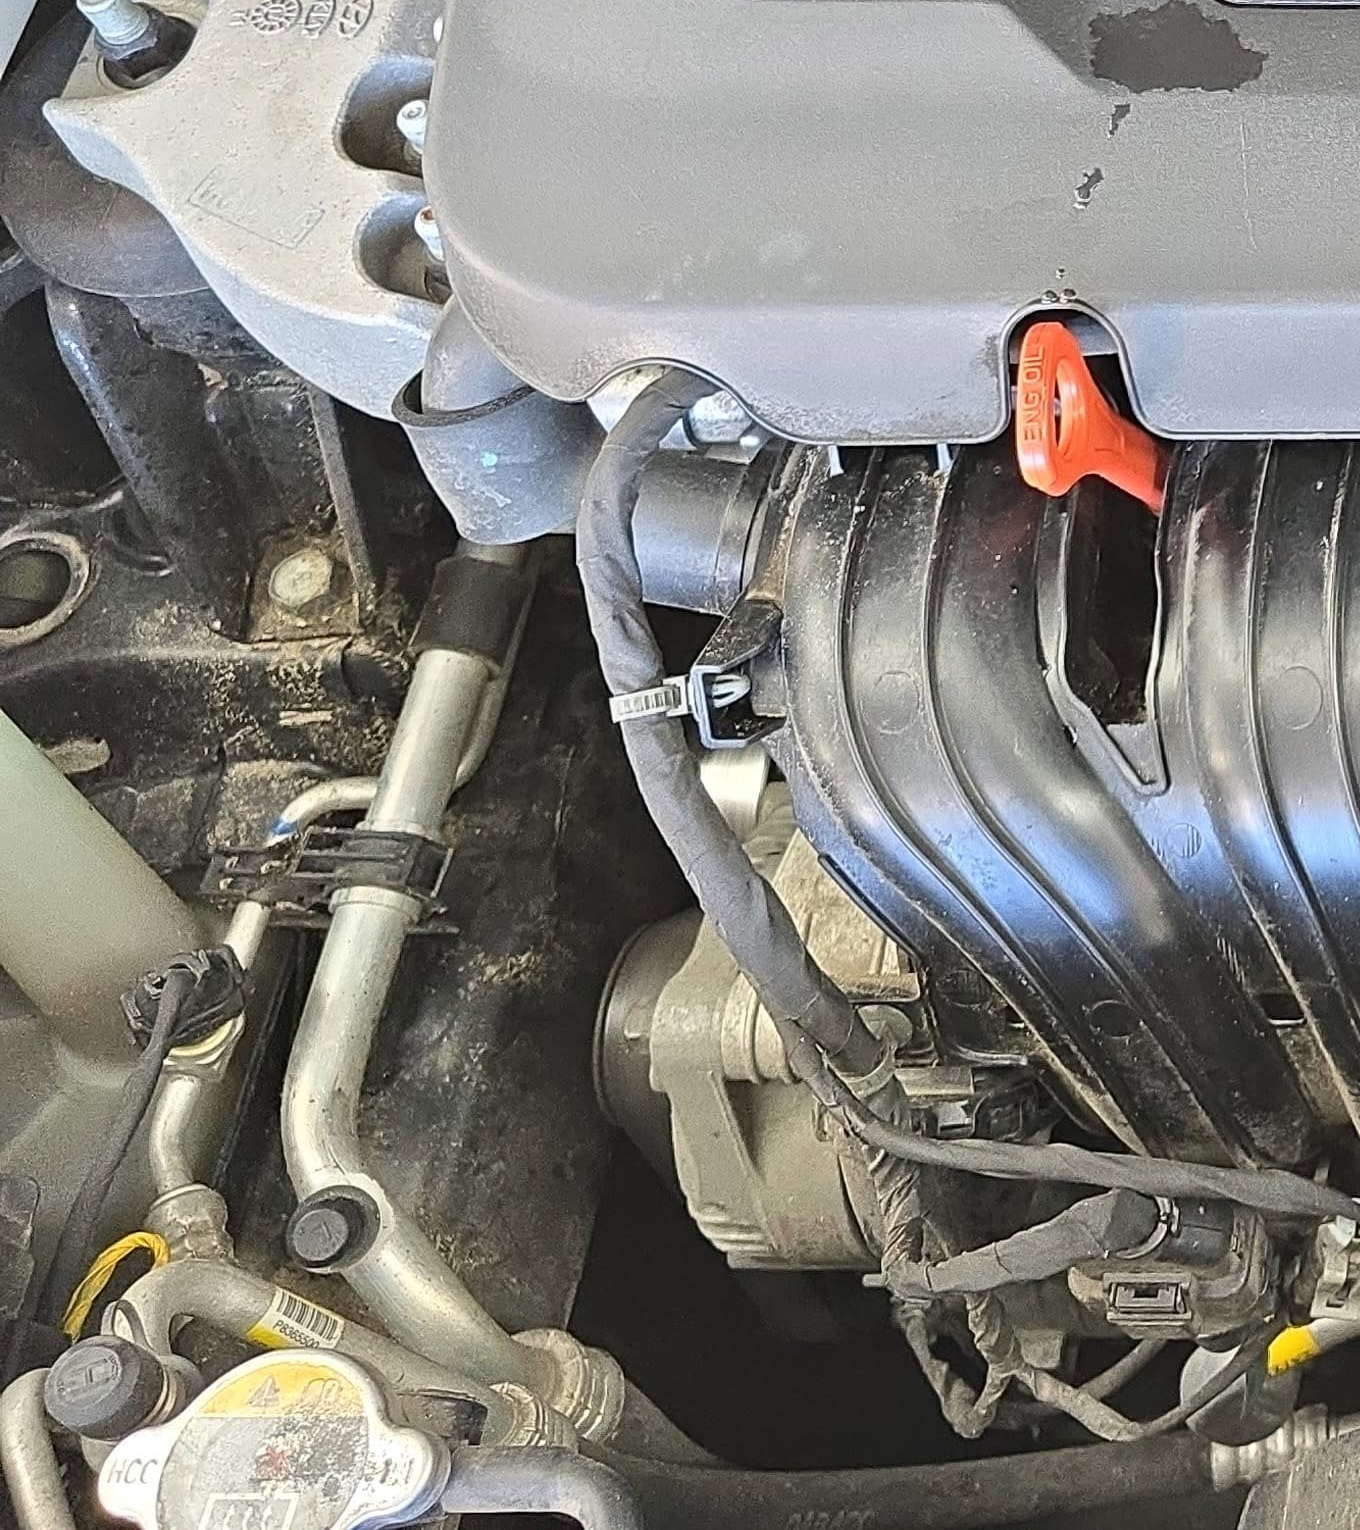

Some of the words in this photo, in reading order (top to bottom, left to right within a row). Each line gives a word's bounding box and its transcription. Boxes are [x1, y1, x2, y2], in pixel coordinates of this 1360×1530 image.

[1025, 345, 1045, 381] OIL
[1022, 391, 1044, 443] ENG
[107, 1458, 159, 1484] HCC
